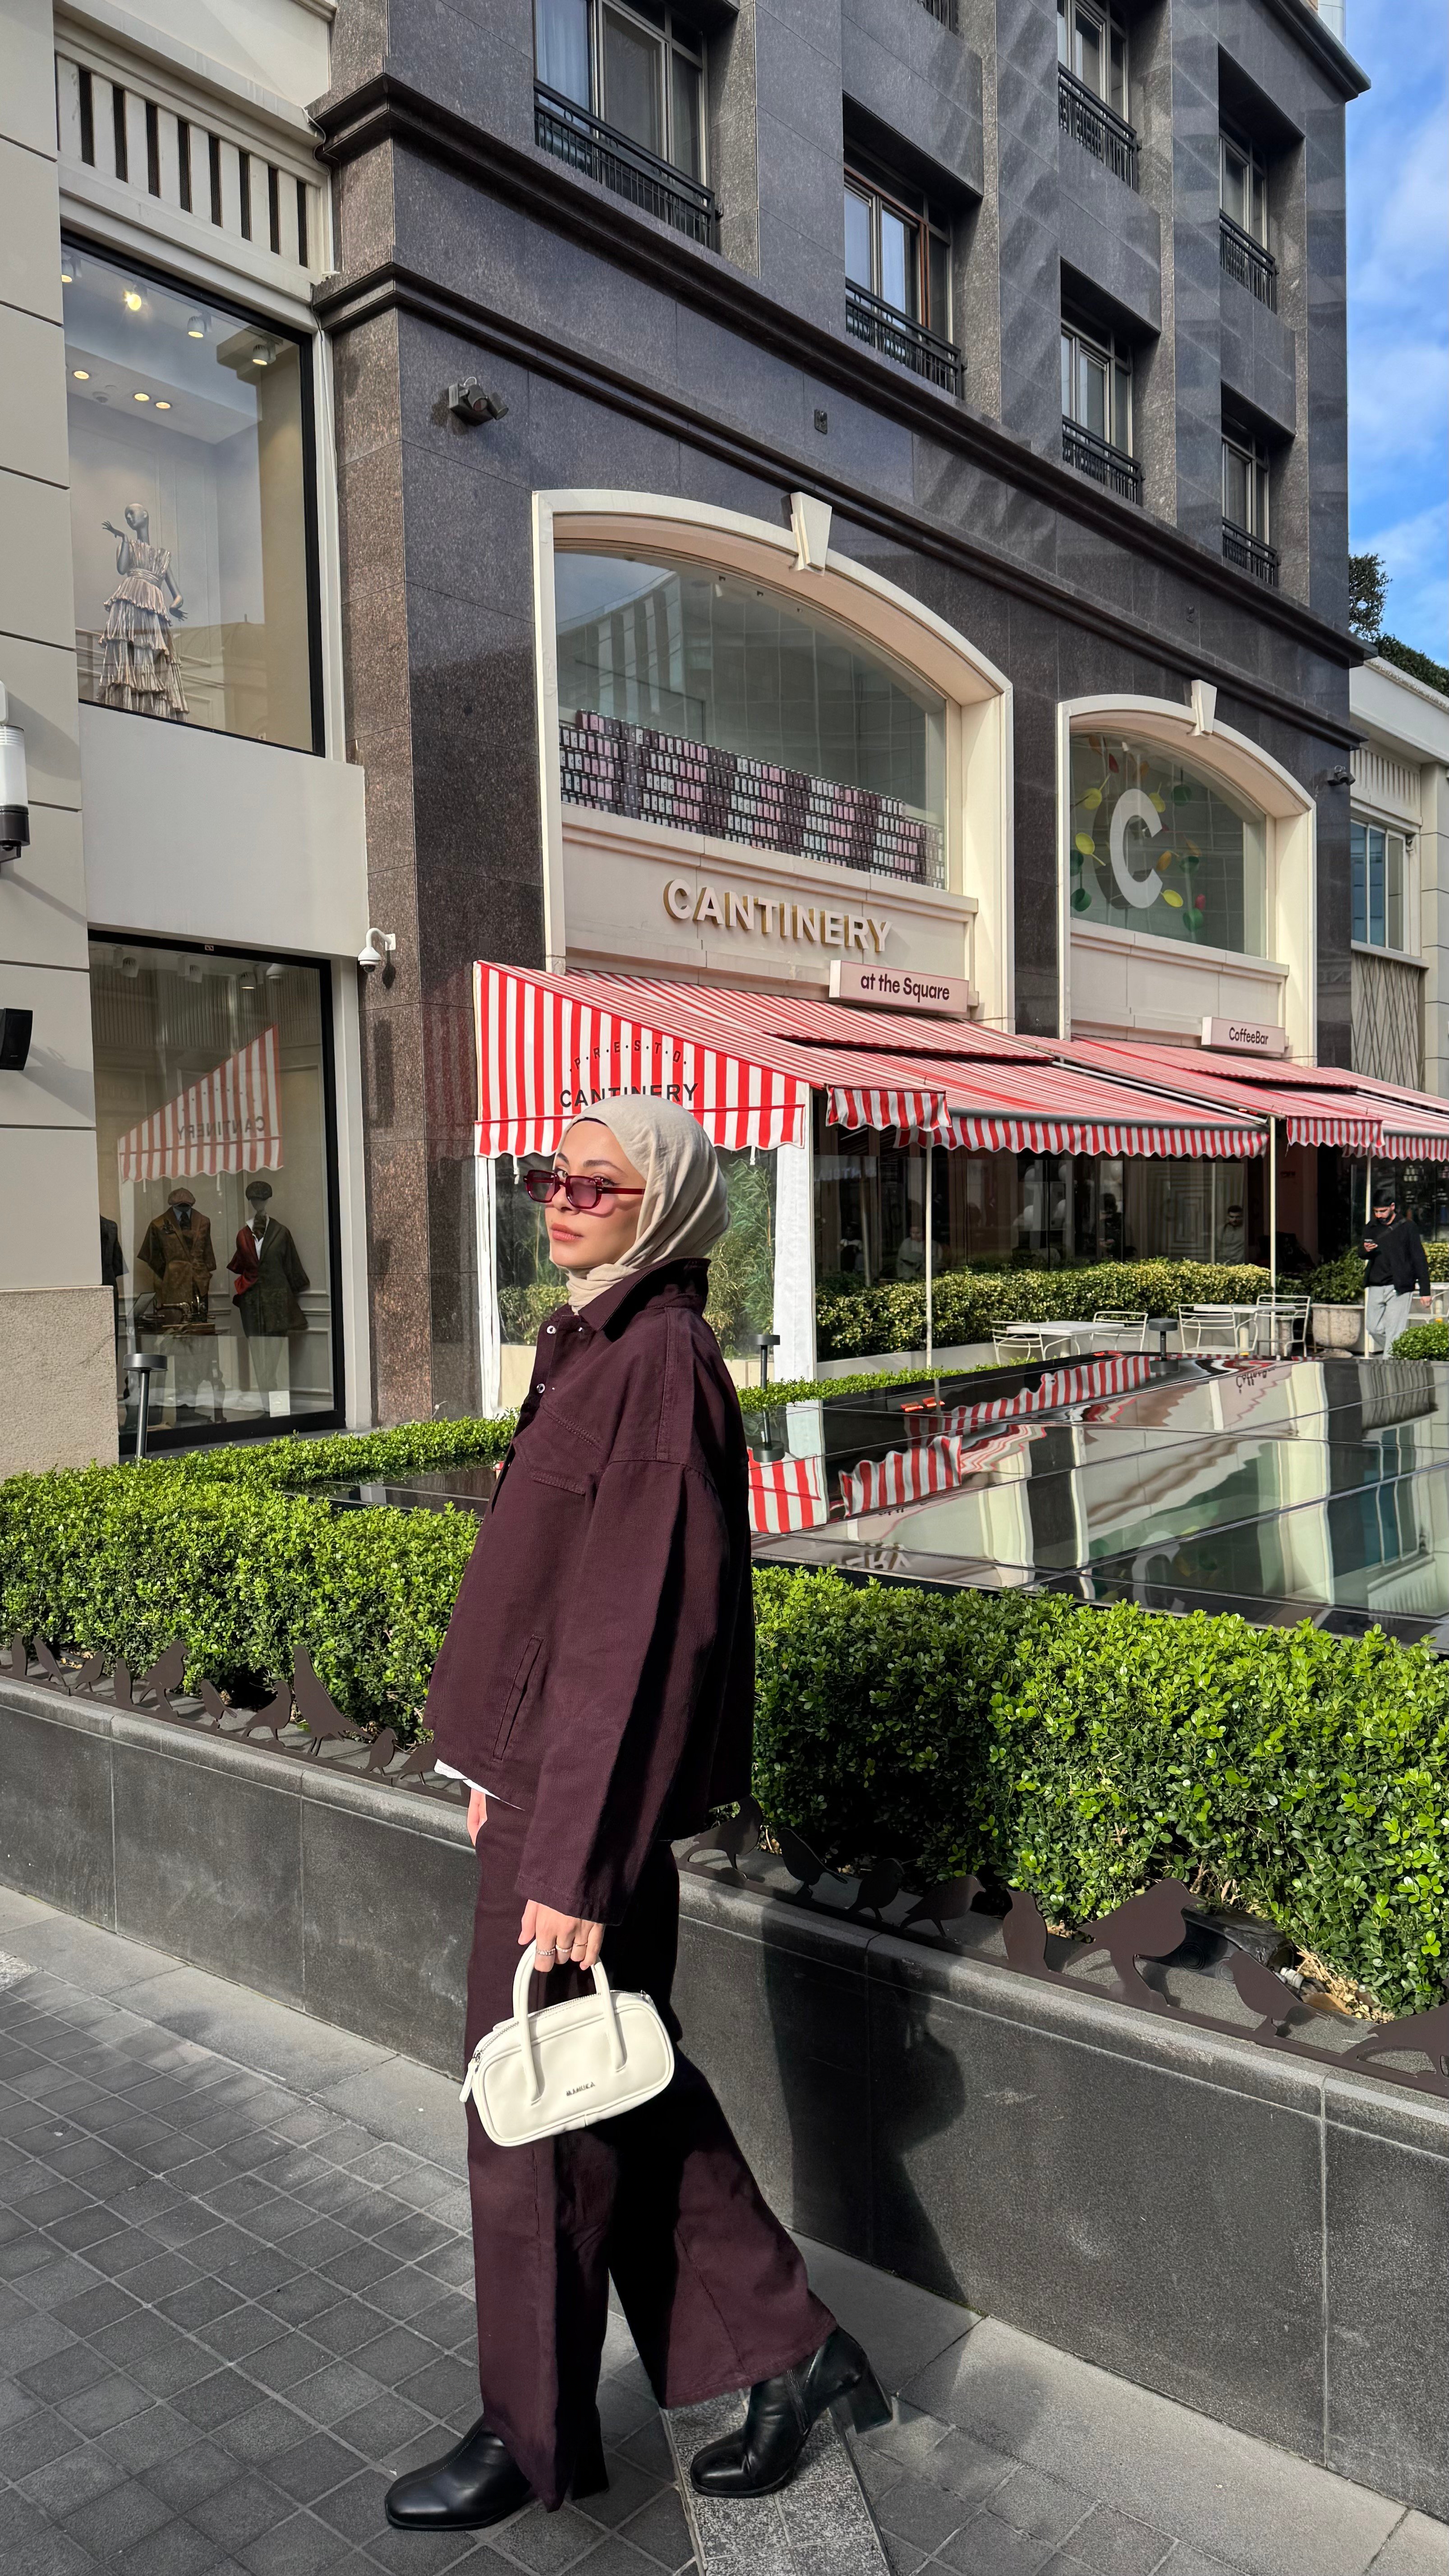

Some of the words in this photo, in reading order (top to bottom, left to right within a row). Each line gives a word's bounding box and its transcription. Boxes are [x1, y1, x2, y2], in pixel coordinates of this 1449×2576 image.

[1110, 788, 1163, 908] C
[663, 879, 892, 952] CANTINERY
[860, 973, 875, 990] at
[879, 974, 900, 993] the
[903, 977, 950, 1003] Square
[1229, 1027, 1269, 1045] CoffeeBar
